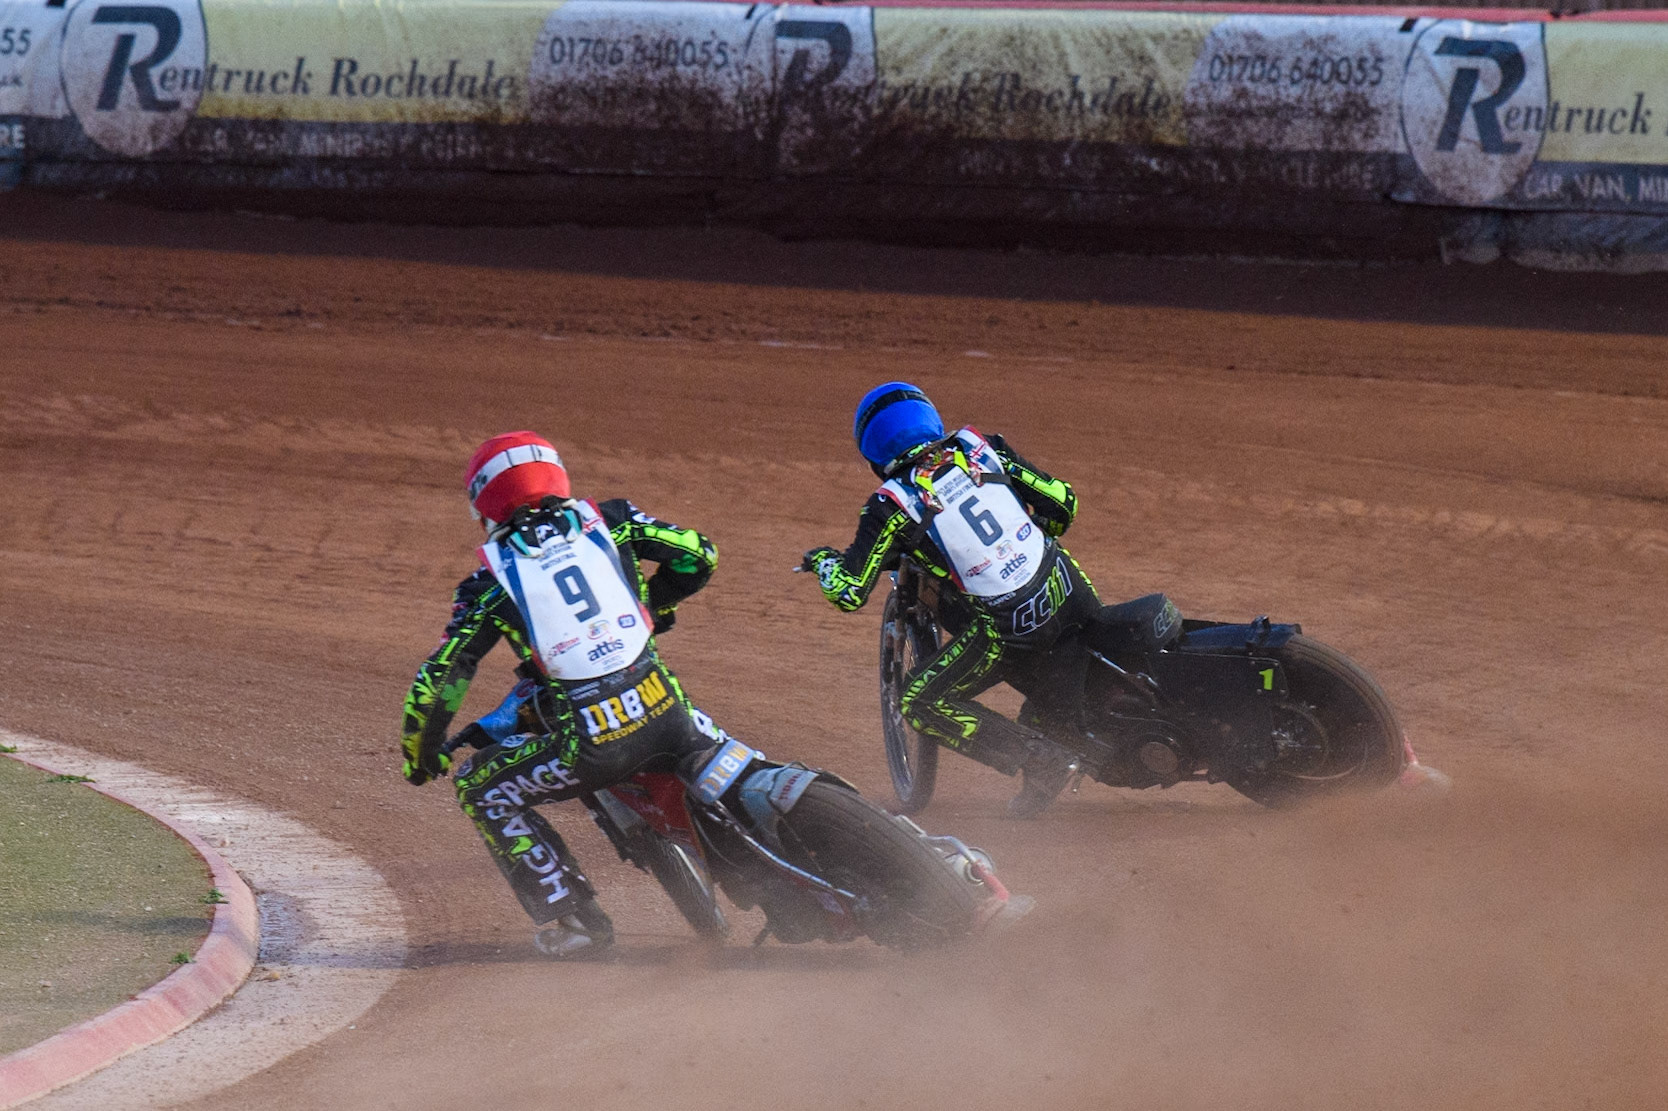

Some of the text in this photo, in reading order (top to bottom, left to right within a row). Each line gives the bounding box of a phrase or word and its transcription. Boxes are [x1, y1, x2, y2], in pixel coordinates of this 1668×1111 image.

[550, 36, 624, 66] 01706
[329, 57, 515, 98] Rochdale
[1209, 55, 1383, 86] 01706 640055
[958, 495, 1003, 547] 6
[999, 552, 1027, 580] attis
[553, 564, 602, 623] 9
[587, 636, 624, 661] attis
[1258, 668, 1274, 690] 1
[591, 696, 676, 746] SPEEDWAY TEAM
